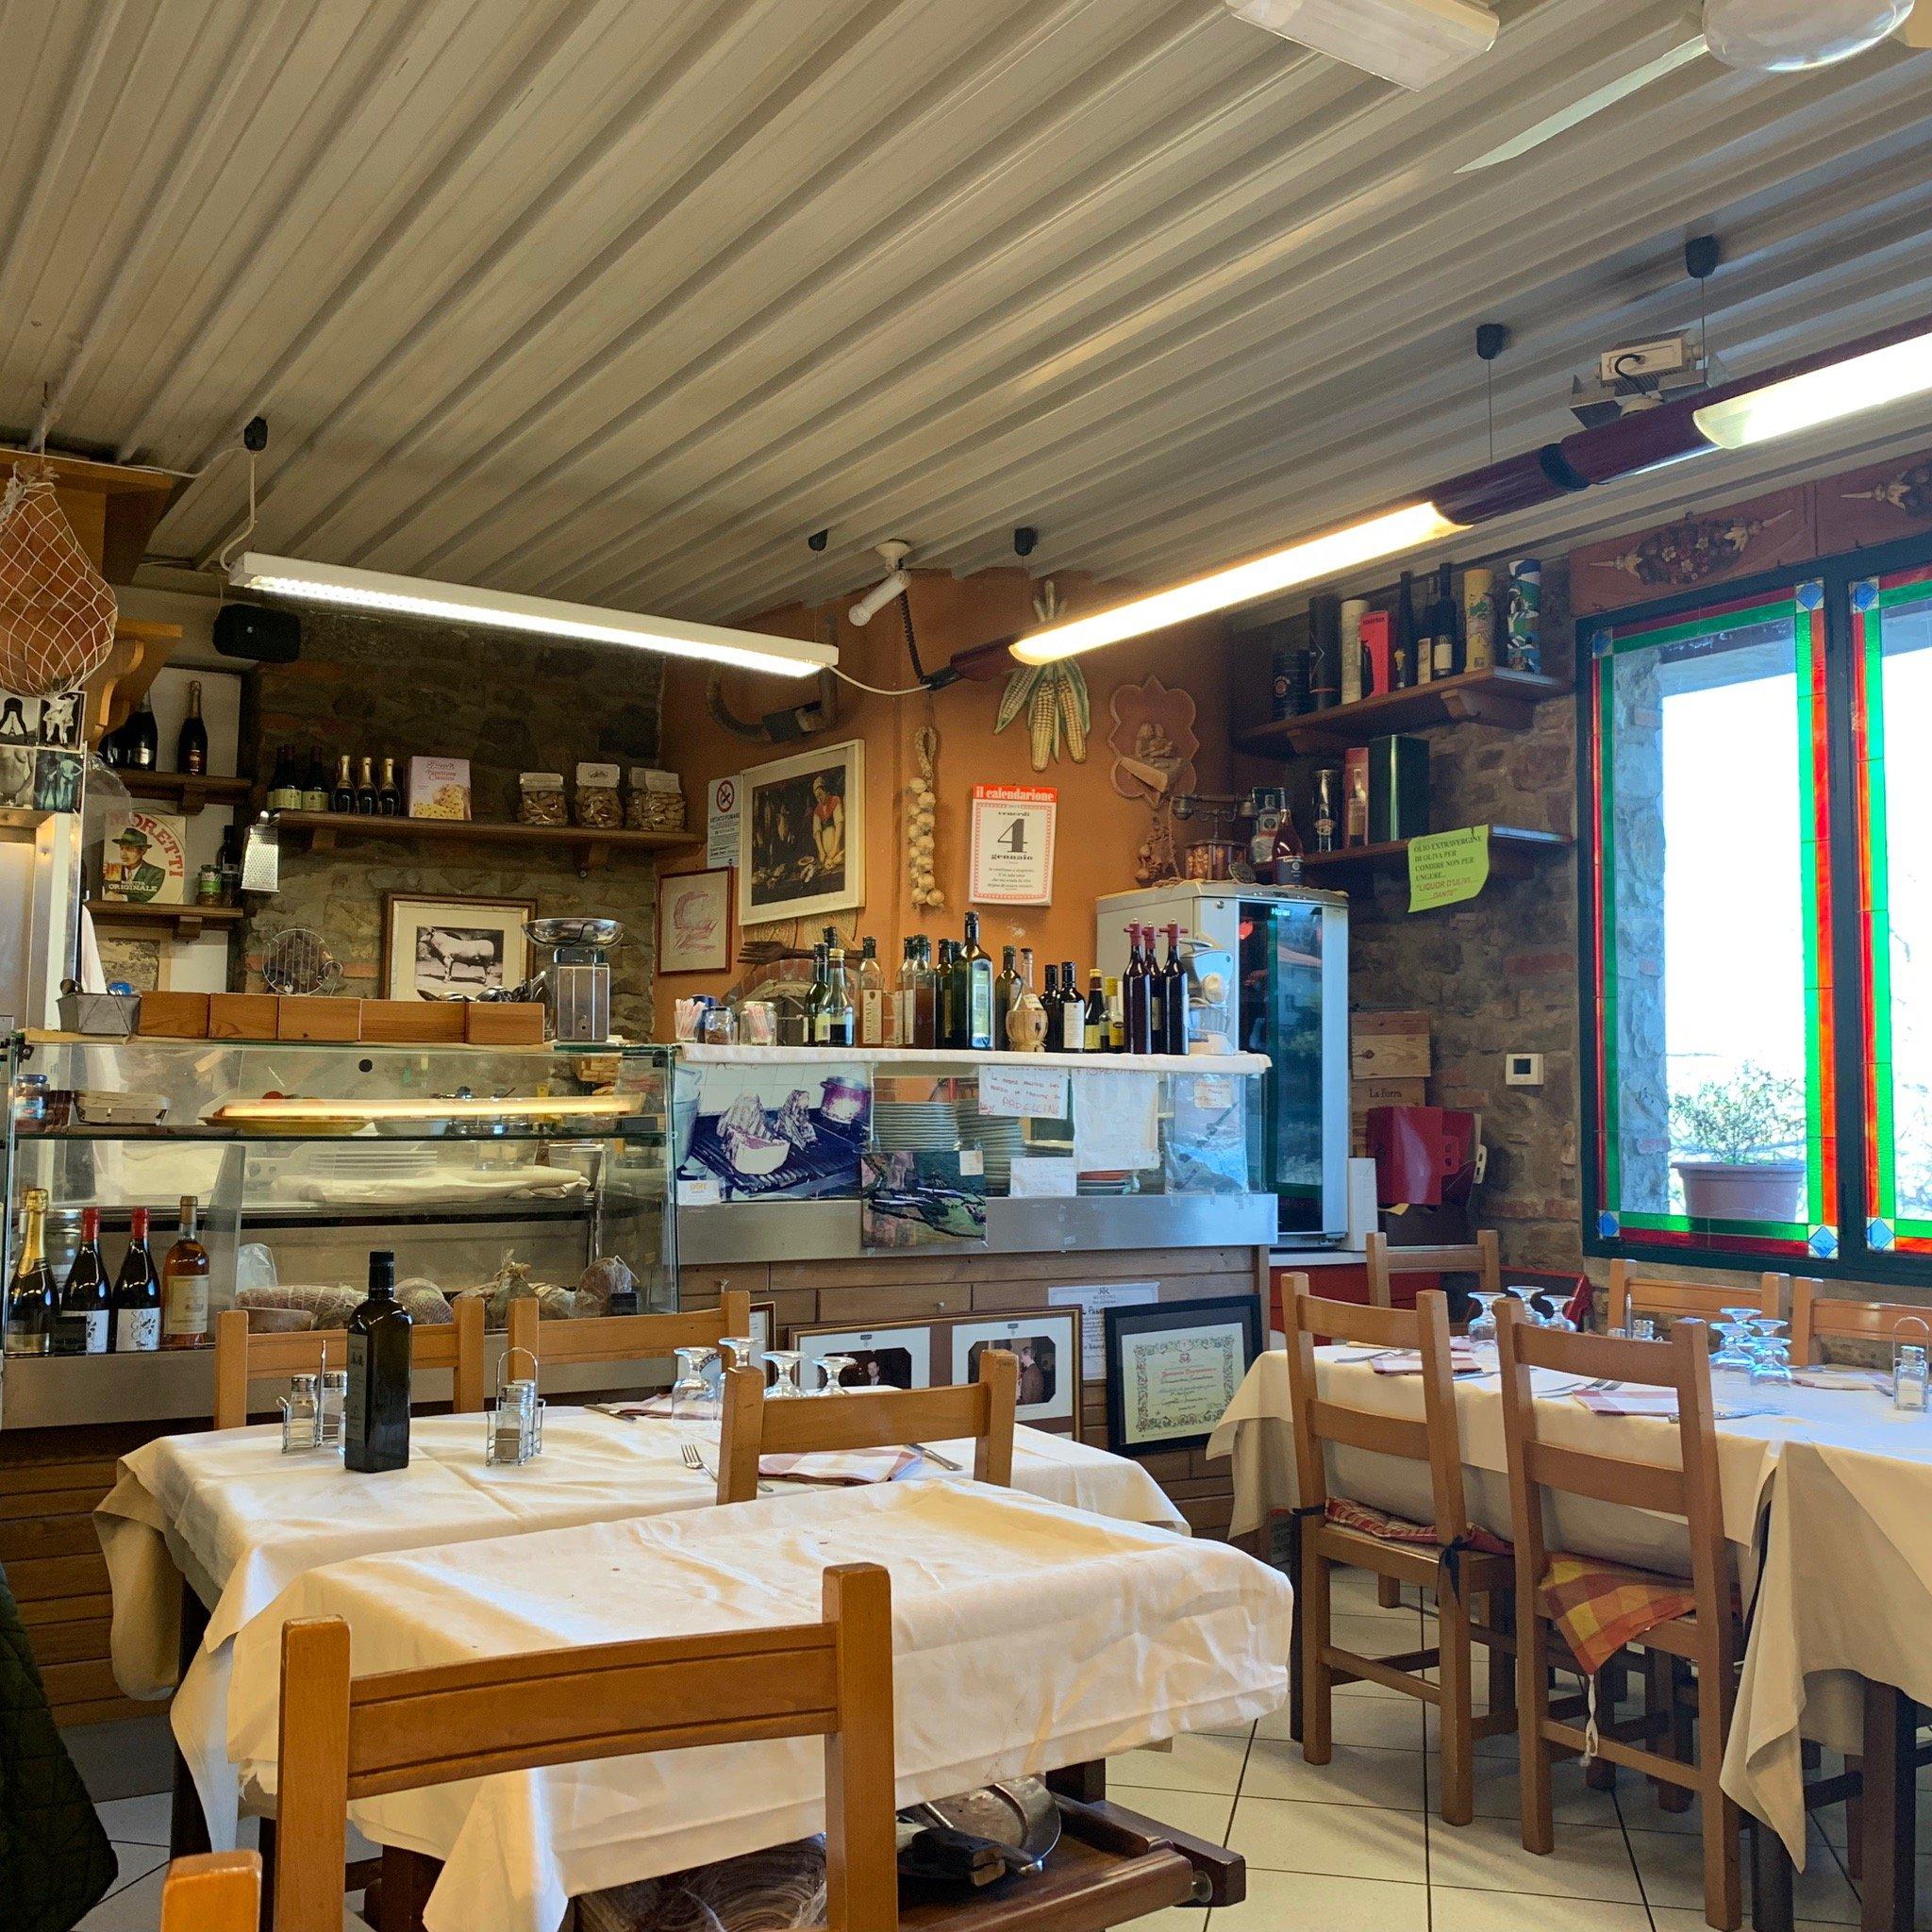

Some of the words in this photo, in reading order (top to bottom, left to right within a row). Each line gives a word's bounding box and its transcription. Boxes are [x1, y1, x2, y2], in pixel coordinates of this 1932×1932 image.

[975, 786, 984, 798] il
[986, 787, 1055, 801] calendarione
[997, 818, 1028, 853] 4
[1413, 844, 1430, 853] OLIO
[108, 883, 158, 891] ORIGINALE
[1369, 1088, 1380, 1098] La
[1381, 1088, 1403, 1098] Forra
